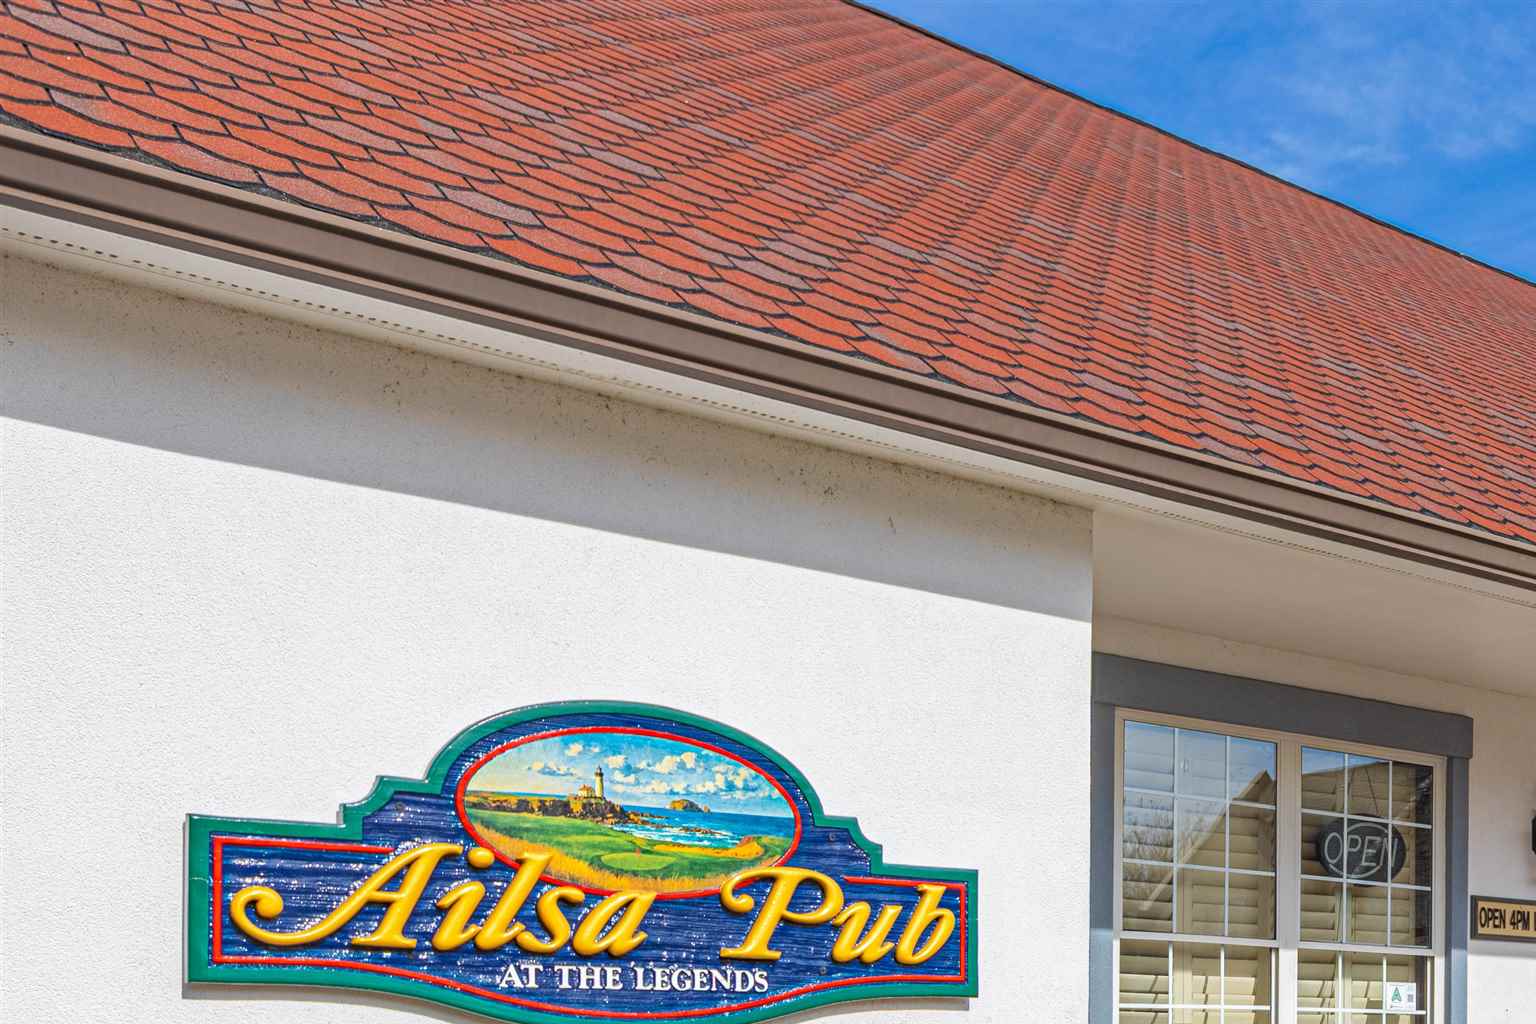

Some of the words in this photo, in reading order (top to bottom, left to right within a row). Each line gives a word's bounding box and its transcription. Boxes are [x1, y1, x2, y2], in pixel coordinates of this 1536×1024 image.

[1324, 832, 1399, 868] OPEN
[229, 840, 656, 957] Ailsa
[719, 867, 959, 966] Pub
[1479, 906, 1506, 929] OPEN
[1509, 909, 1530, 931] 4PM
[499, 963, 543, 989] AT
[554, 963, 624, 990] THE
[633, 966, 769, 993] LEGENDS
